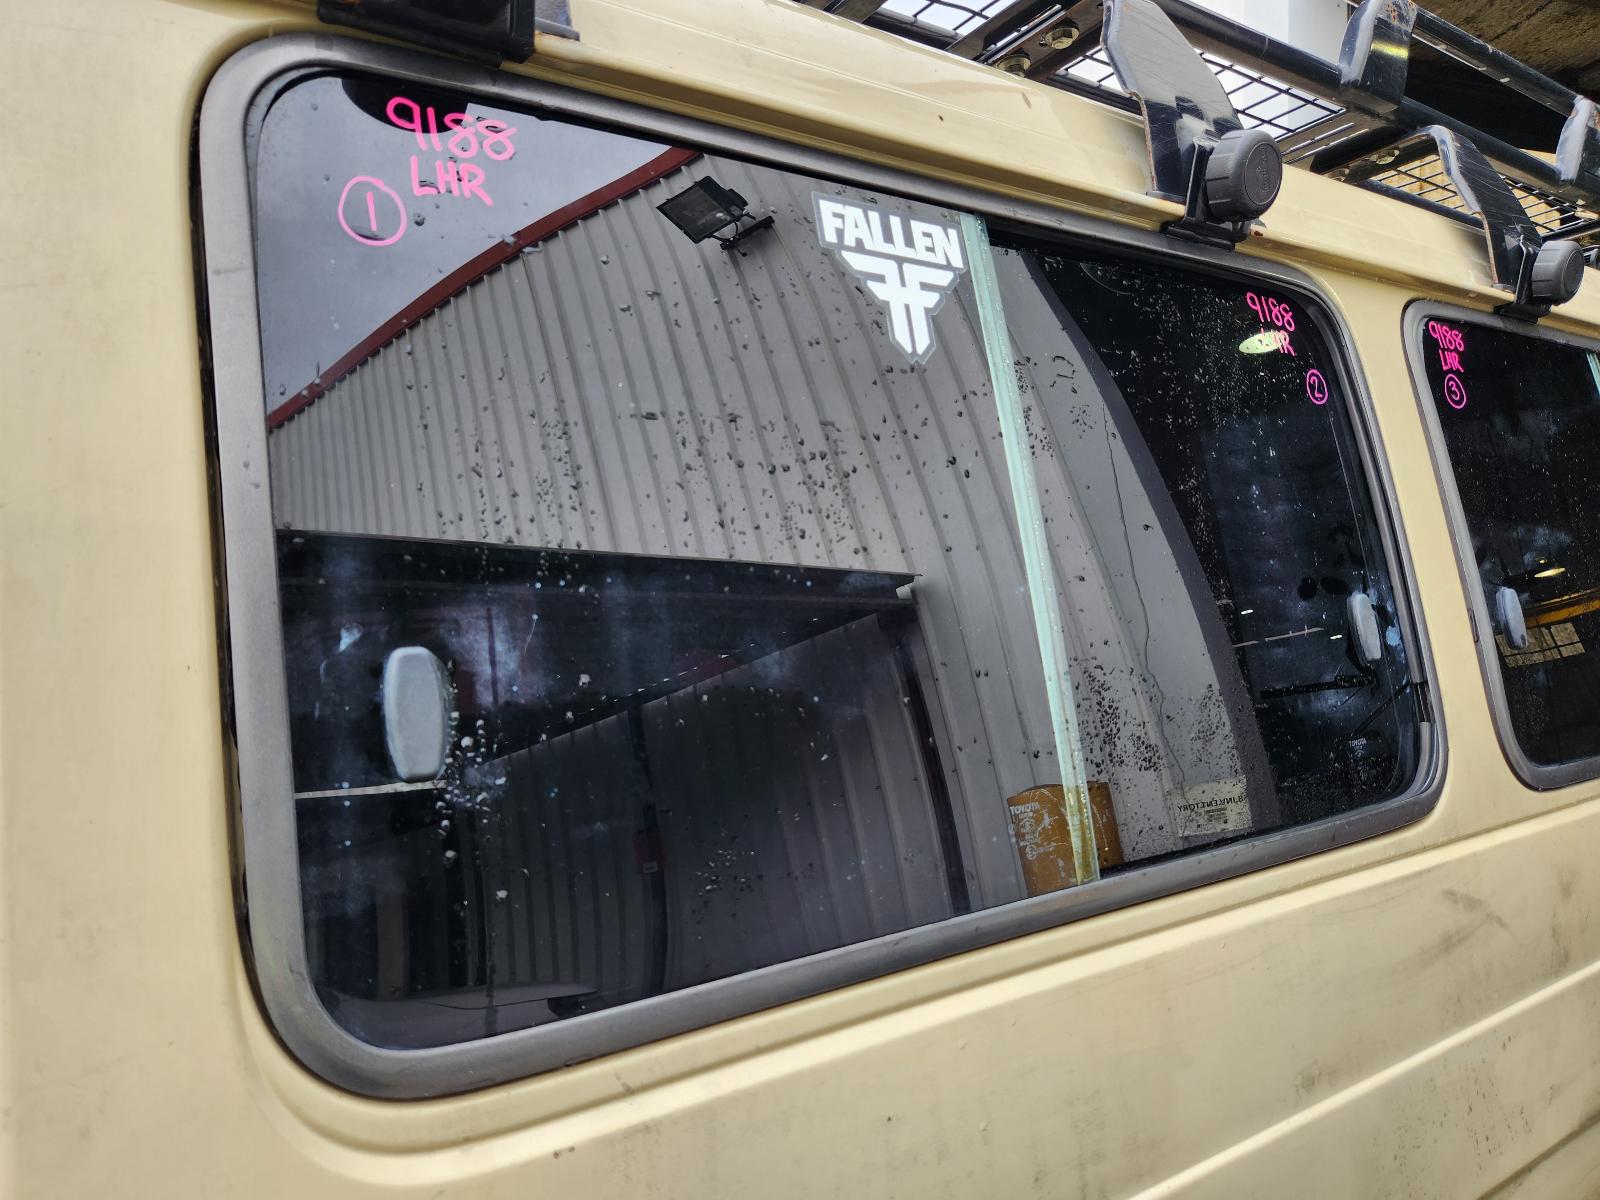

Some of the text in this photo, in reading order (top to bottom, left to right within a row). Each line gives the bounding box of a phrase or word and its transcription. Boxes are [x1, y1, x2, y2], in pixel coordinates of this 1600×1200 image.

[386, 97, 518, 161] 9188
[410, 155, 494, 206] LHR
[818, 199, 964, 269] FALLEN
[1246, 292, 1295, 332] 9188
[1428, 321, 1465, 352] 9188
[1439, 349, 1464, 373] LHR
